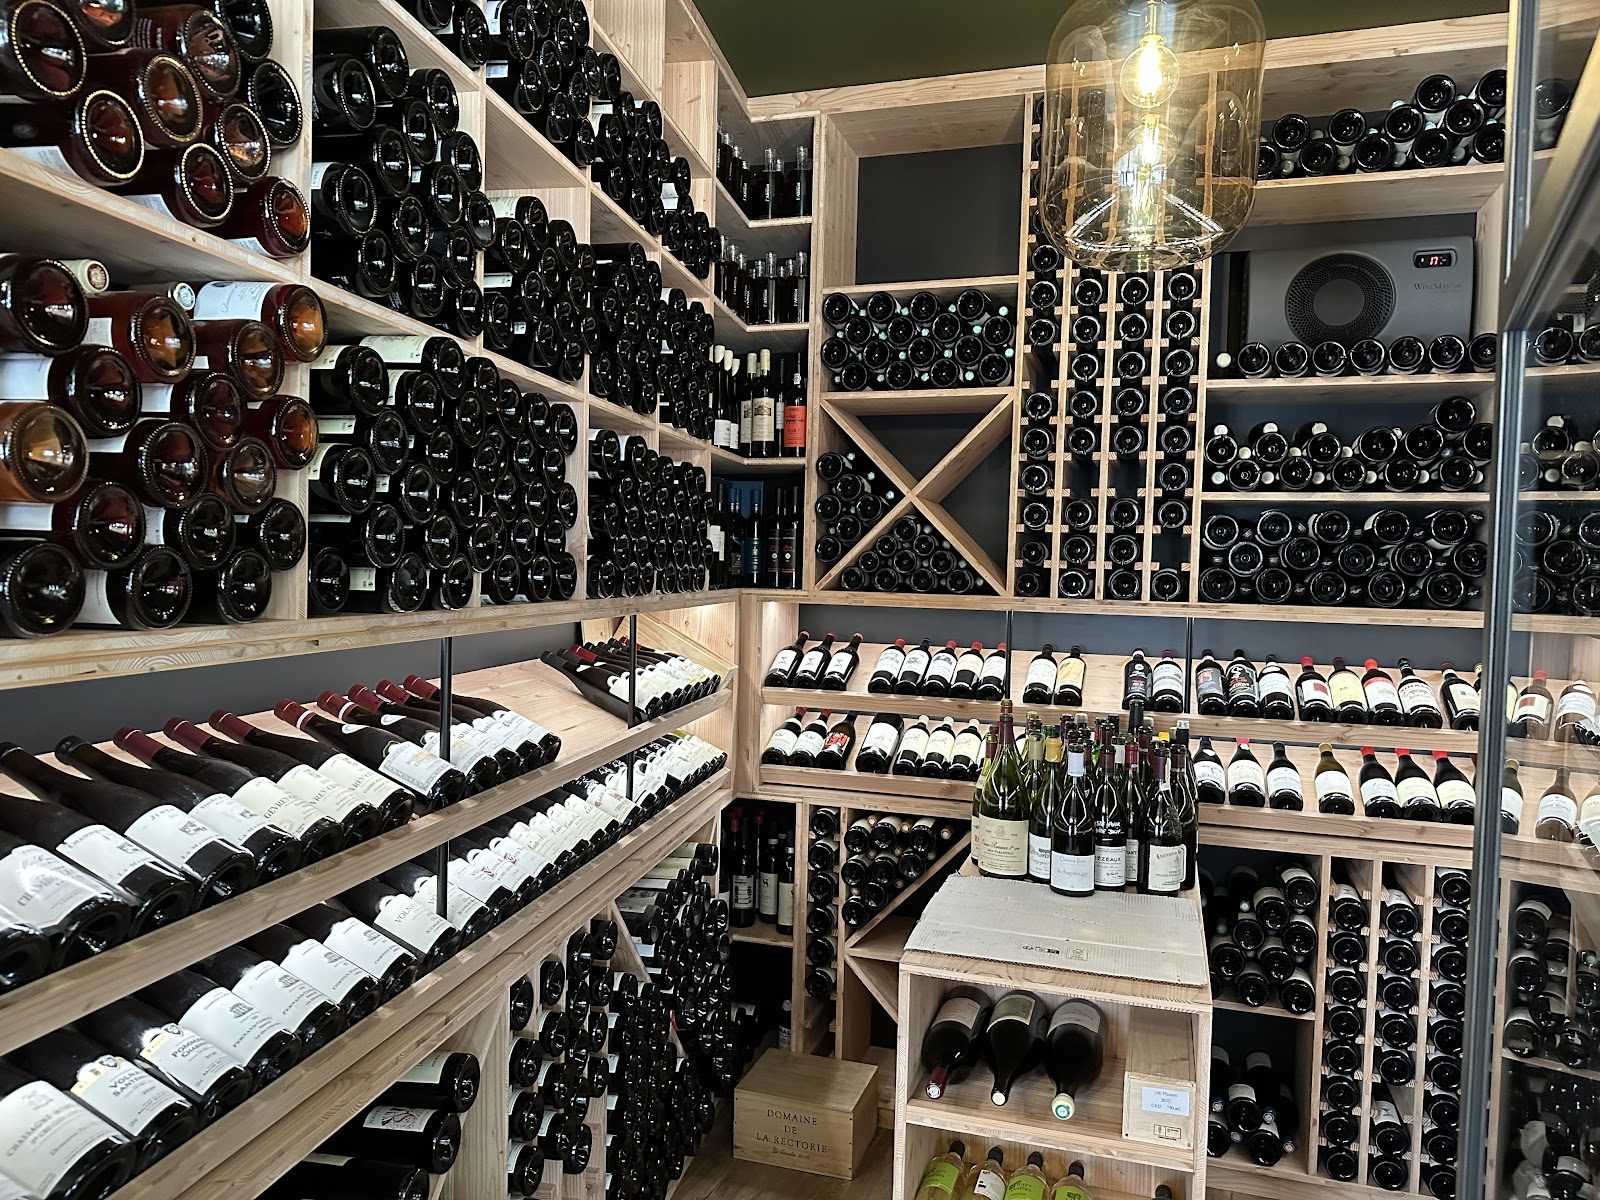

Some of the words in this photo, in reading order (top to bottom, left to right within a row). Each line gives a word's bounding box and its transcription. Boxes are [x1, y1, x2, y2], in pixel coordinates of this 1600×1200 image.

[767, 1109, 818, 1126] DOMAINE
[784, 1125, 798, 1135] DE
[756, 1132, 769, 1142] LA
[773, 1135, 828, 1153] RECTORIE
